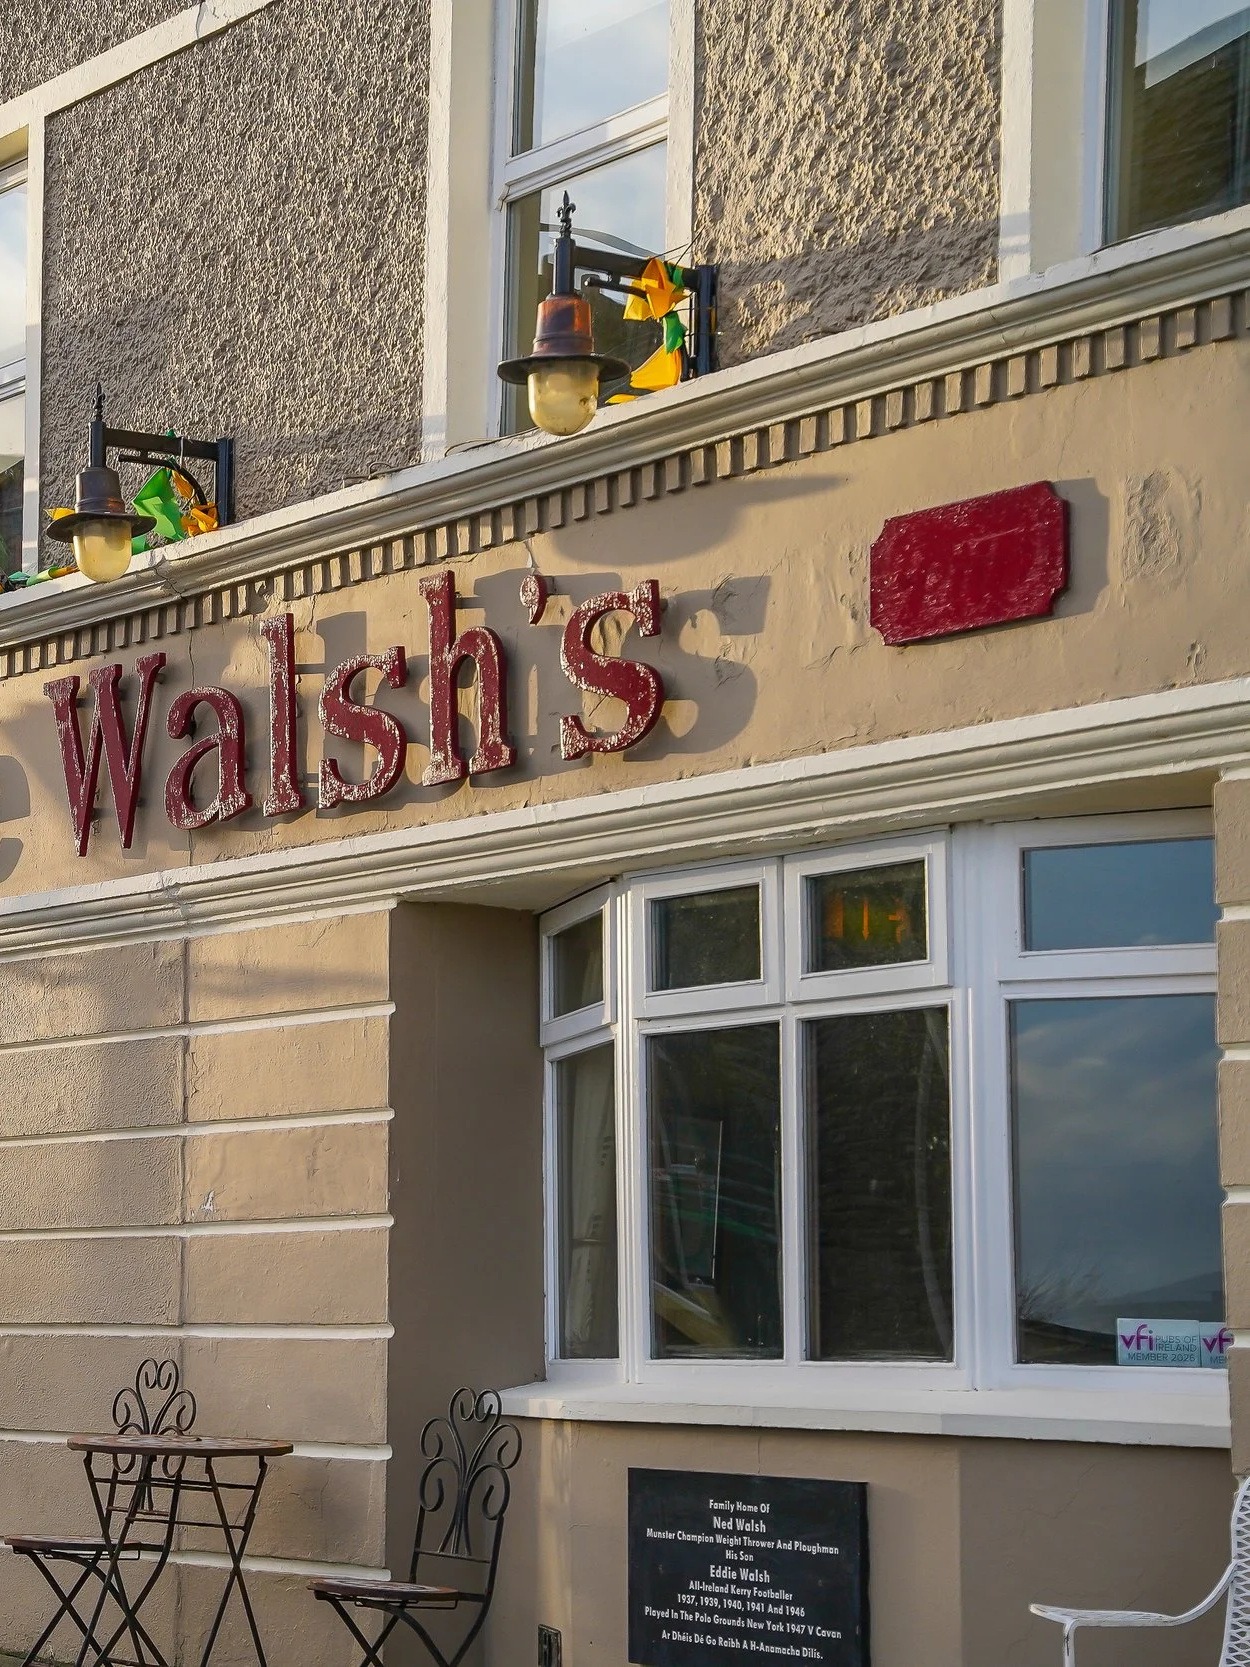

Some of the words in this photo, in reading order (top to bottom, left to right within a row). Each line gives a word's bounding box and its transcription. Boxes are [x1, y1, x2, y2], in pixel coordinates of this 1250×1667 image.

[43, 570, 664, 857] Walsh's
[1120, 1324, 1154, 1351] vfi
[1155, 1335, 1181, 1343] PUBS
[1183, 1335, 1197, 1343] OF
[1155, 1343, 1197, 1352] IRELAND
[1128, 1353, 1168, 1361] MEMBER
[1171, 1354, 1196, 1362] 2026
[710, 1500, 734, 1512] Family
[737, 1501, 758, 1513] Home
[760, 1504, 770, 1514] Of
[713, 1517, 733, 1530] Ned
[736, 1518, 766, 1533] Walsh
[647, 1528, 675, 1540] Munster
[677, 1531, 714, 1544] Champion
[716, 1534, 741, 1546] Weight
[743, 1537, 775, 1549] Thrower
[777, 1540, 792, 1550] And
[795, 1542, 839, 1555] Ploughman
[726, 1550, 738, 1560] His
[740, 1551, 754, 1562] Son
[710, 1565, 737, 1580] Eddie
[740, 1567, 770, 1583] Walsh
[689, 1581, 728, 1594] All-Ireland
[731, 1585, 751, 1597] Kerry
[754, 1587, 792, 1600] Footballer
[677, 1594, 698, 1606] 1937,
[700, 1596, 721, 1608] 1939,
[723, 1599, 744, 1611] 1940,
[747, 1602, 765, 1612] 1941
[768, 1604, 783, 1615] And
[786, 1606, 805, 1617] 1946
[645, 1606, 669, 1619] Played
[671, 1609, 678, 1619] In
[680, 1611, 693, 1621] The
[695, 1612, 712, 1623] Polo
[713, 1615, 745, 1627] Grounds
[747, 1618, 764, 1629] New
[766, 1620, 784, 1631] York
[786, 1622, 805, 1634] 1947
[808, 1625, 814, 1635] V
[816, 1626, 841, 1639] Cavan
[662, 1630, 670, 1640] Ar
[694, 1633, 704, 1644] Dé
[706, 1636, 717, 1646] Go
[719, 1636, 741, 1649] Raibh
[743, 1640, 748, 1649] A
[750, 1641, 800, 1656] H-Anamacha
